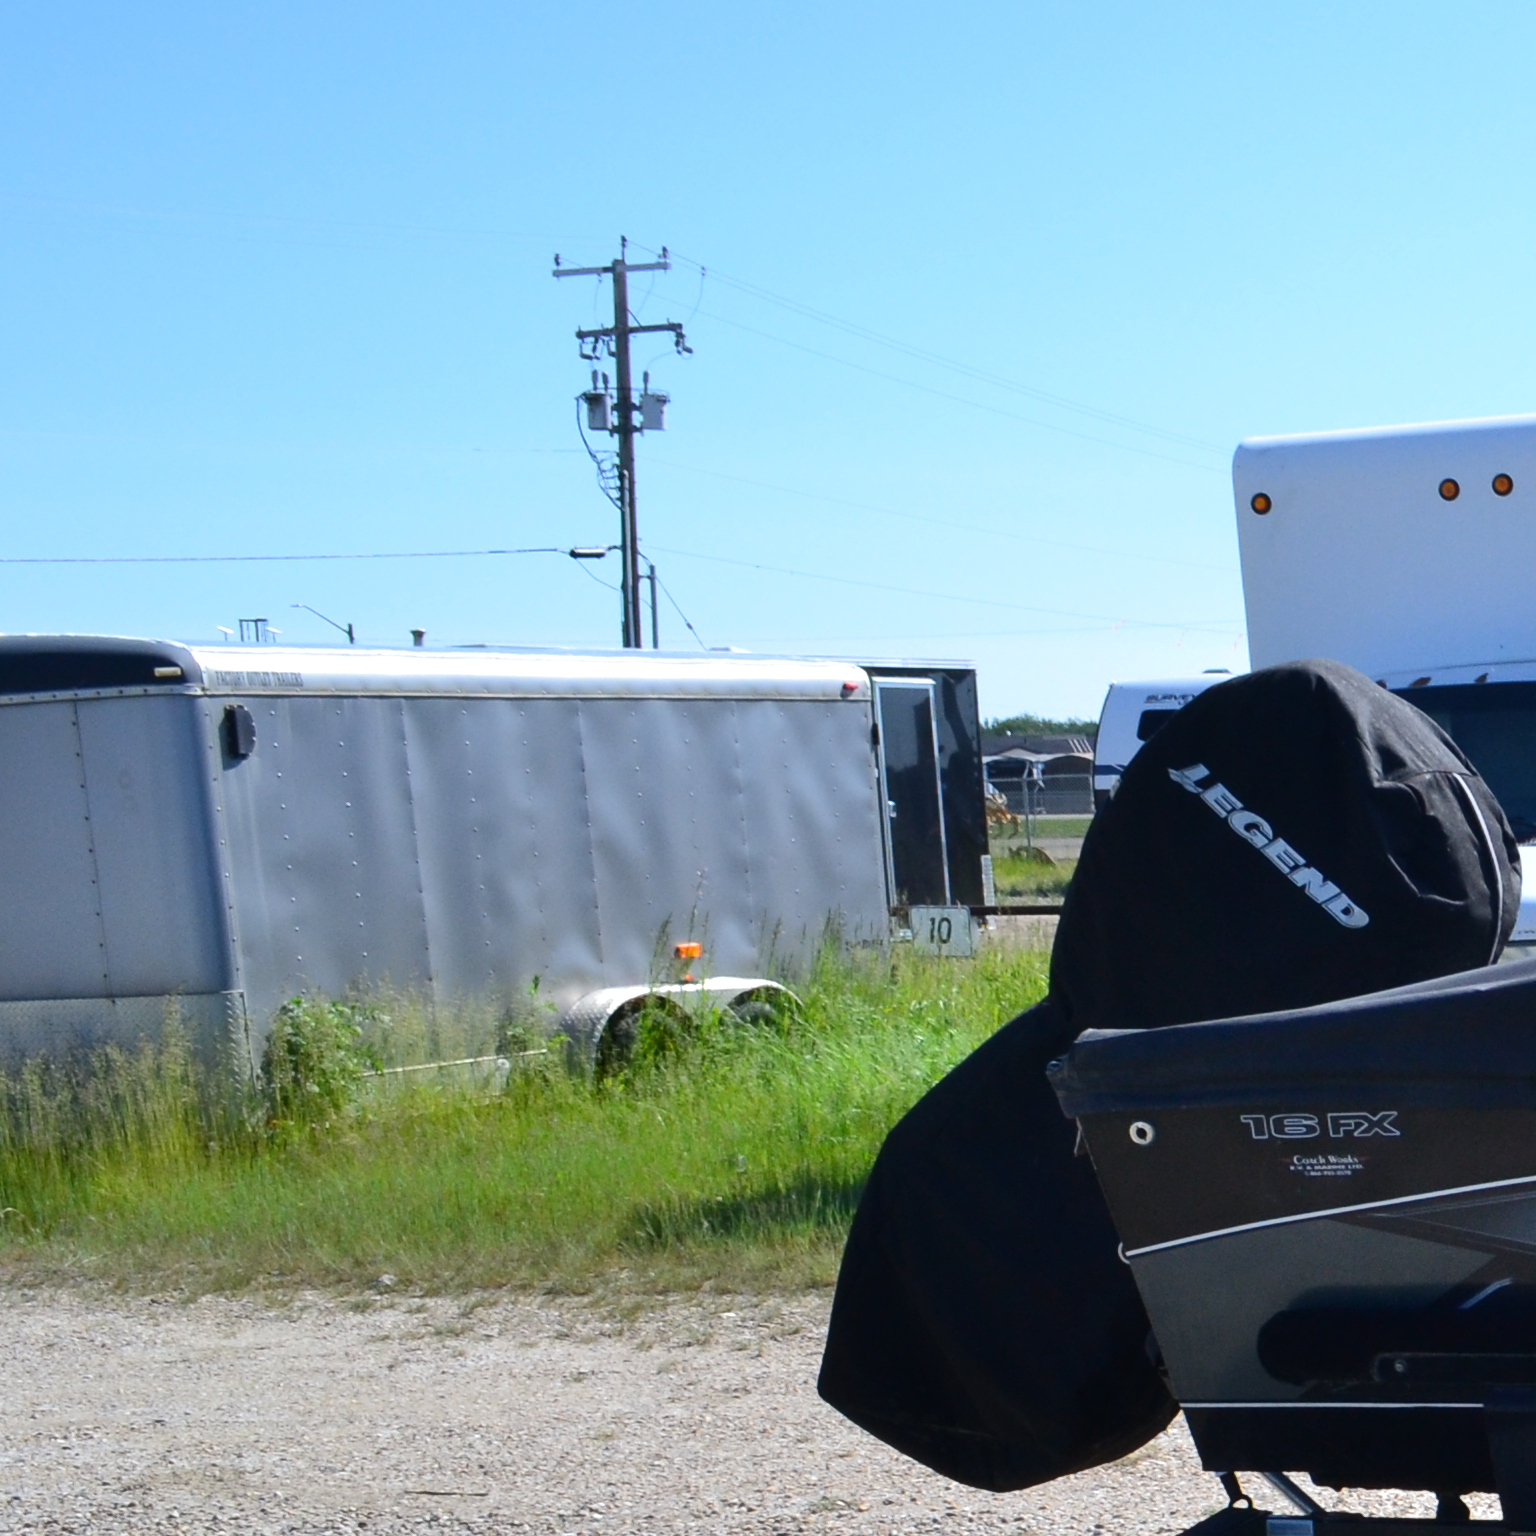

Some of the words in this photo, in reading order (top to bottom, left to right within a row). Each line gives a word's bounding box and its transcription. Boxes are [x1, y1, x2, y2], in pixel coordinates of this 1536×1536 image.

[270, 671, 304, 688] TRAILERS
[1167, 763, 1370, 929] LEGEND
[929, 916, 953, 945] 10
[1240, 1113, 1321, 1139] 16
[1327, 1110, 1401, 1138] FX
